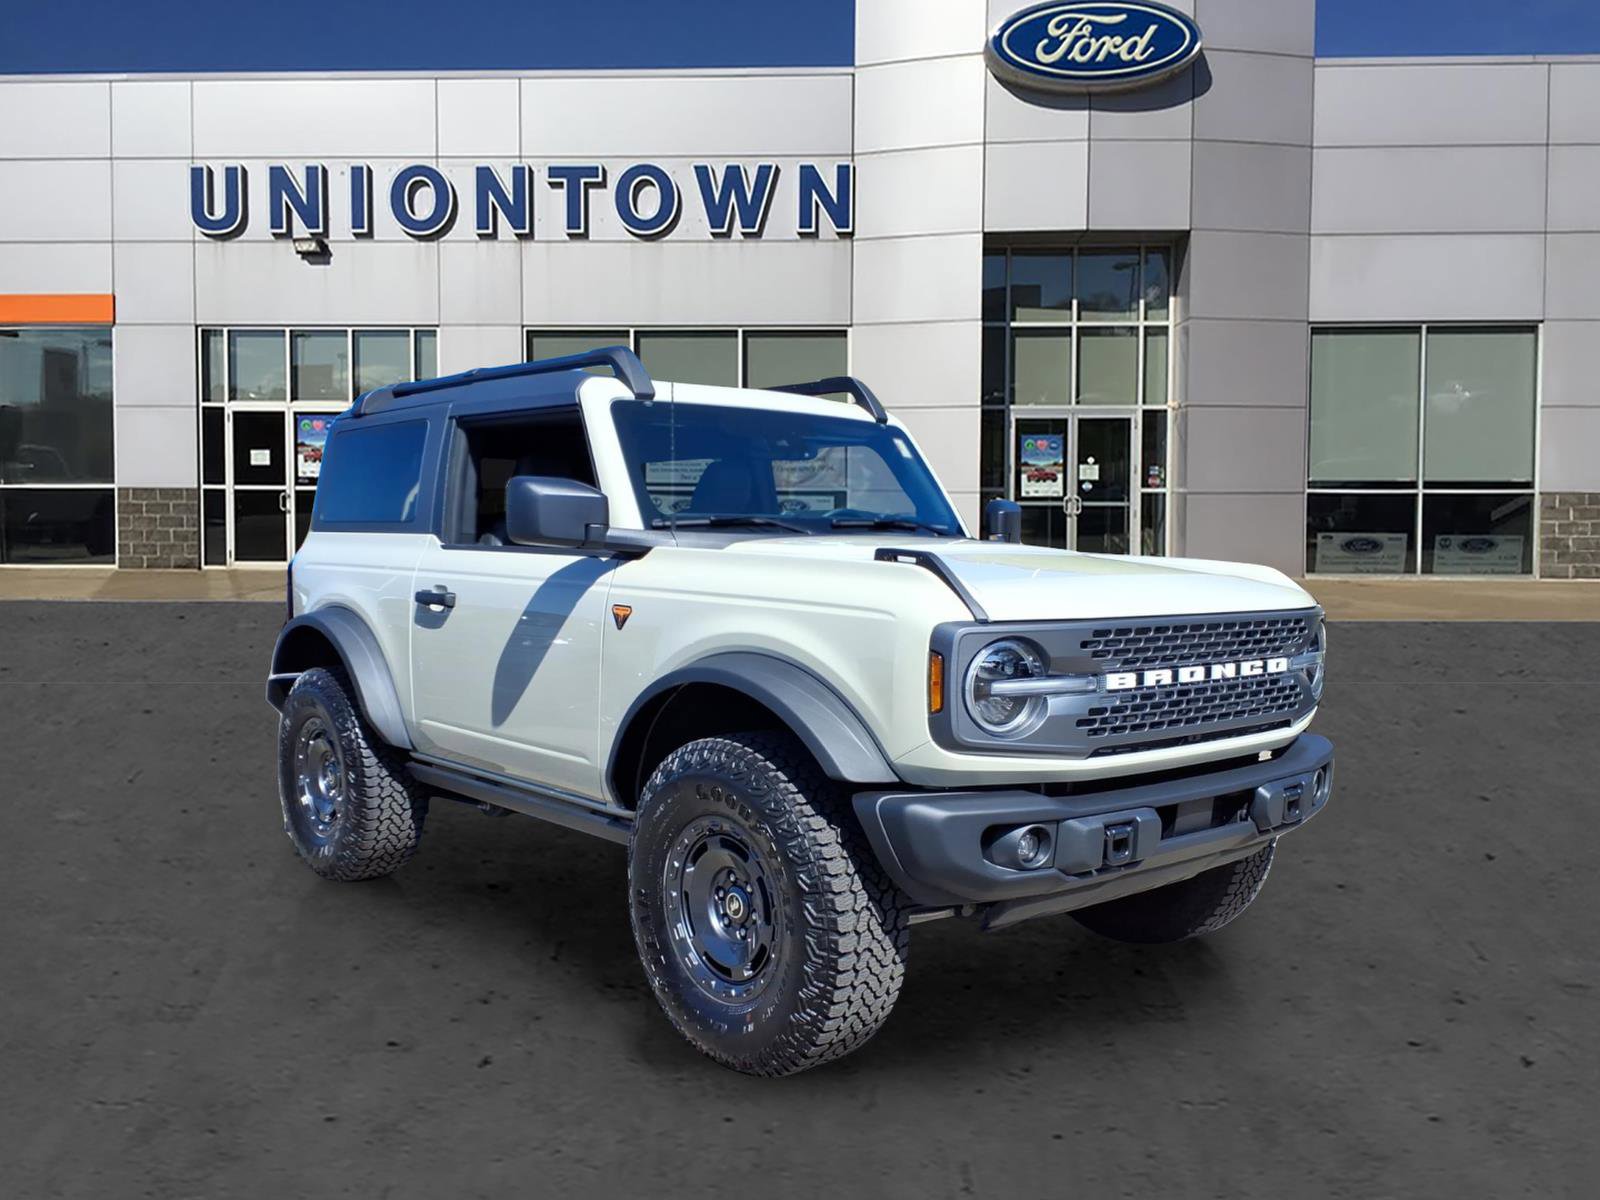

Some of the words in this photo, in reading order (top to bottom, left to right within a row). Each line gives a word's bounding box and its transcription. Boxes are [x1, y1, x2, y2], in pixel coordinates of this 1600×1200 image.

[1035, 12, 1159, 64] Ford
[189, 162, 854, 238] UNIONTOWN
[1105, 656, 1289, 691] BRONCO
